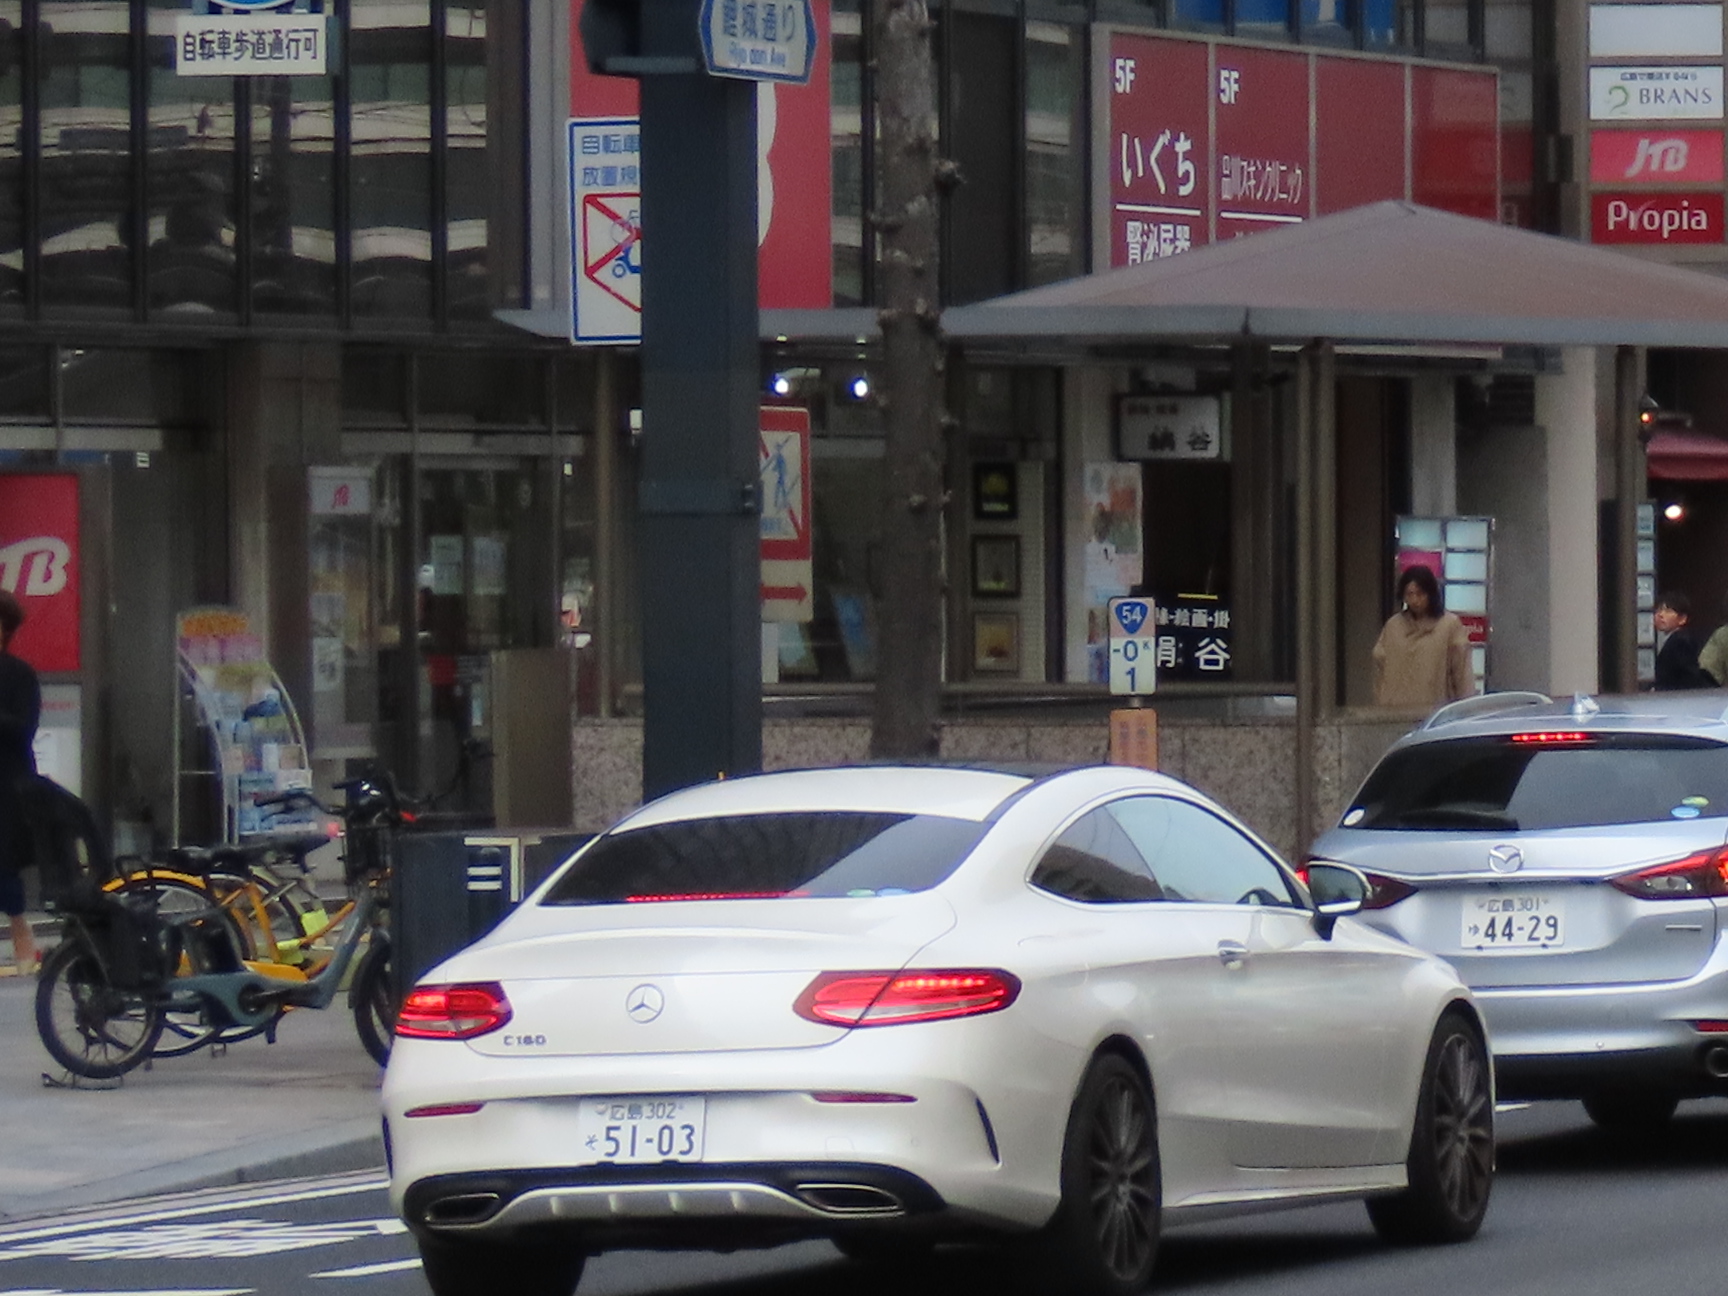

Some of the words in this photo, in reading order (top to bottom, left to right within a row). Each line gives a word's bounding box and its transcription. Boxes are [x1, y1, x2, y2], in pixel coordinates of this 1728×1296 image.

[1114, 58, 1136, 94] 5F
[1219, 69, 1241, 105] 5F
[1638, 86, 1713, 106] BRANS
[1120, 127, 1196, 198] いぐち
[1625, 137, 1689, 178] JTB
[1607, 199, 1709, 239] Propia
[1121, 605, 1143, 625] 54
[1483, 914, 1560, 943] 44-29
[645, 1102, 677, 1120] 302
[603, 1123, 696, 1158] 51-03
